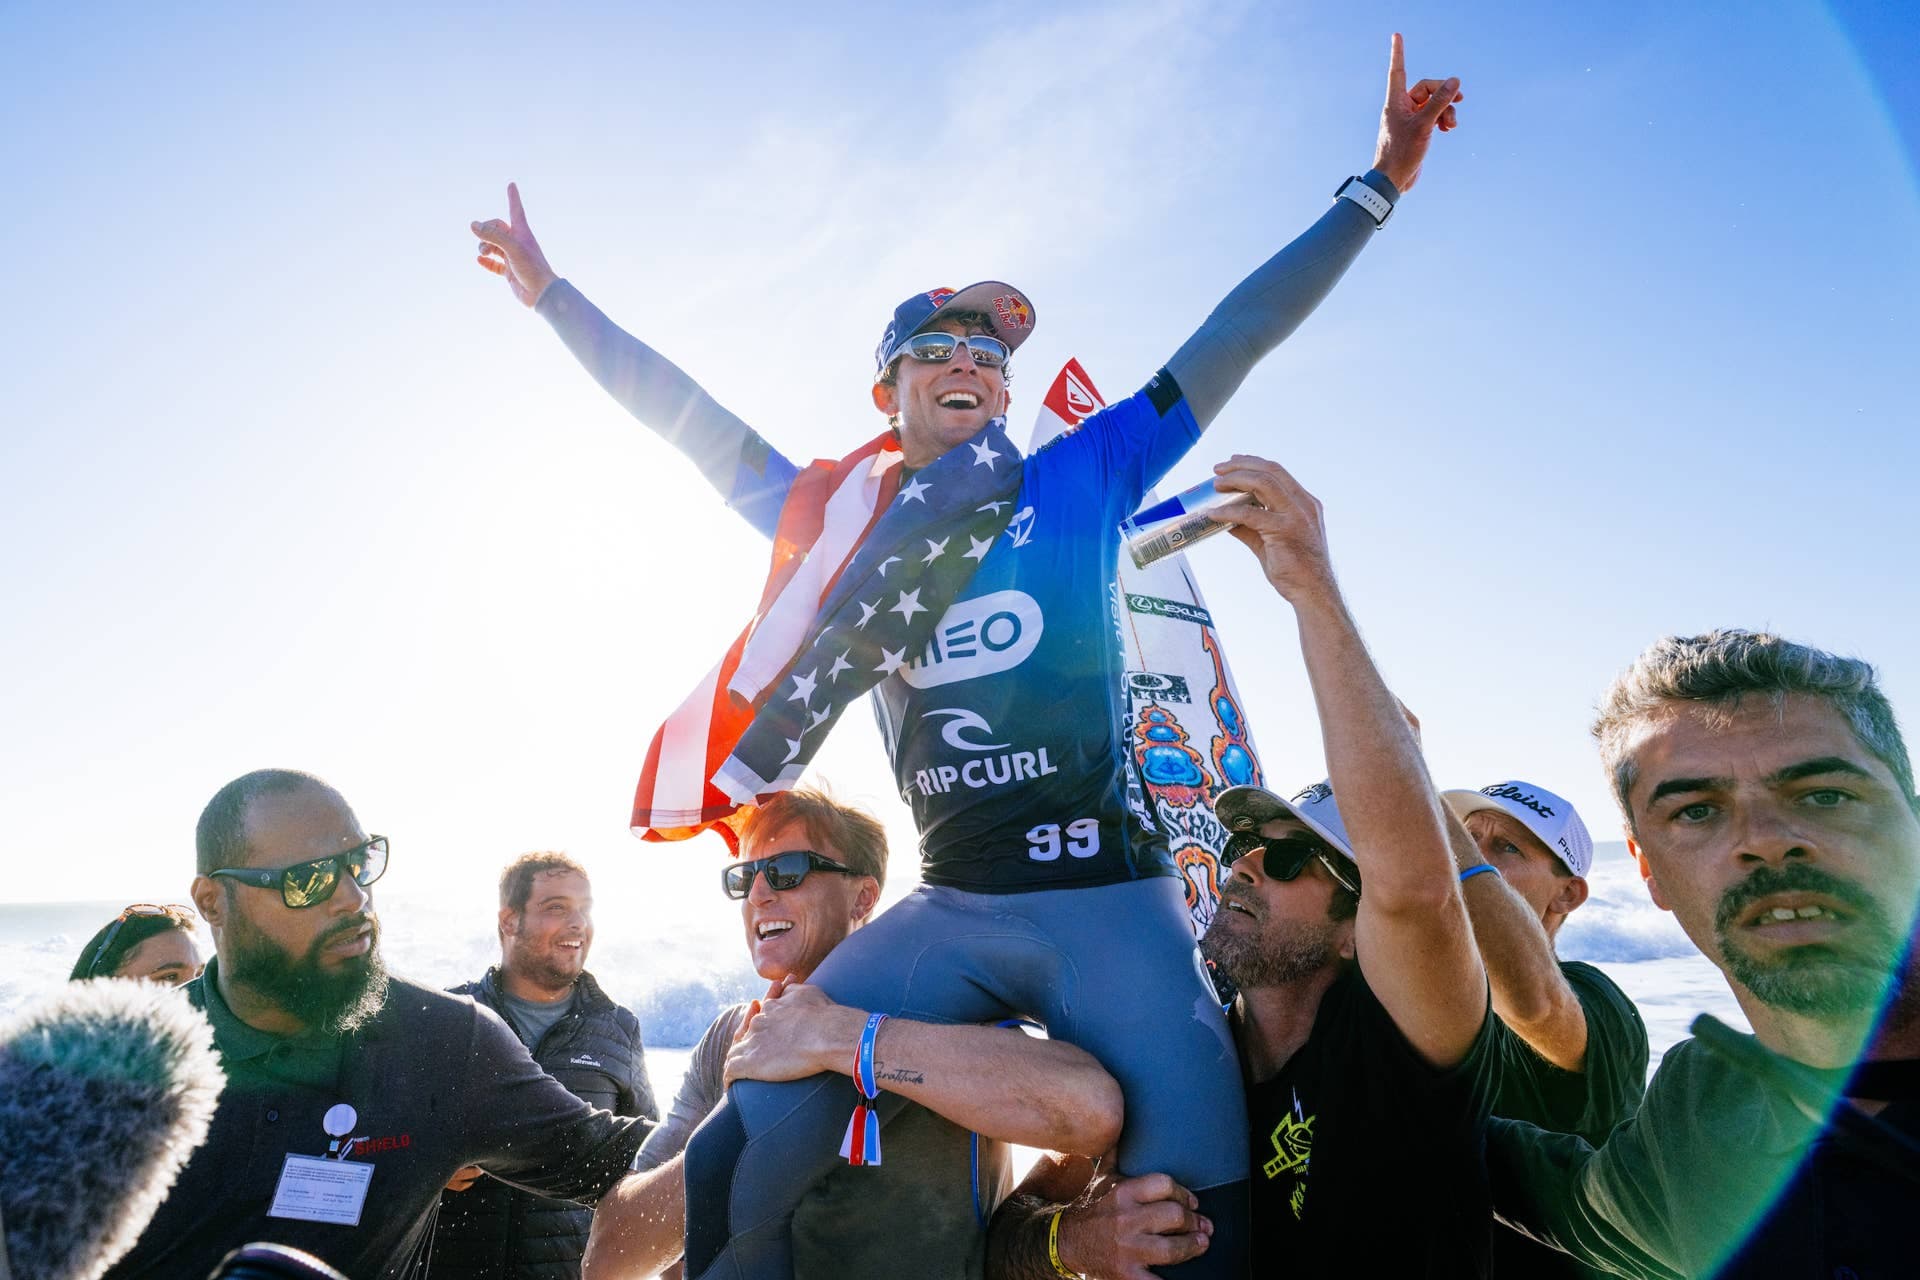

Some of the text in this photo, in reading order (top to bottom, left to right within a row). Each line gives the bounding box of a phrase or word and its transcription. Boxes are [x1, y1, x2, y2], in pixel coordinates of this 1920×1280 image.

[992, 297, 1016, 329] Red Bull
[1153, 602, 1209, 622] LEXUS
[961, 747, 1058, 789] CURL
[1025, 818, 1100, 862] 99
[1558, 837, 1576, 865] PRO
[873, 1061, 924, 1085] Gratitude
[354, 1134, 410, 1156] SHIELD
